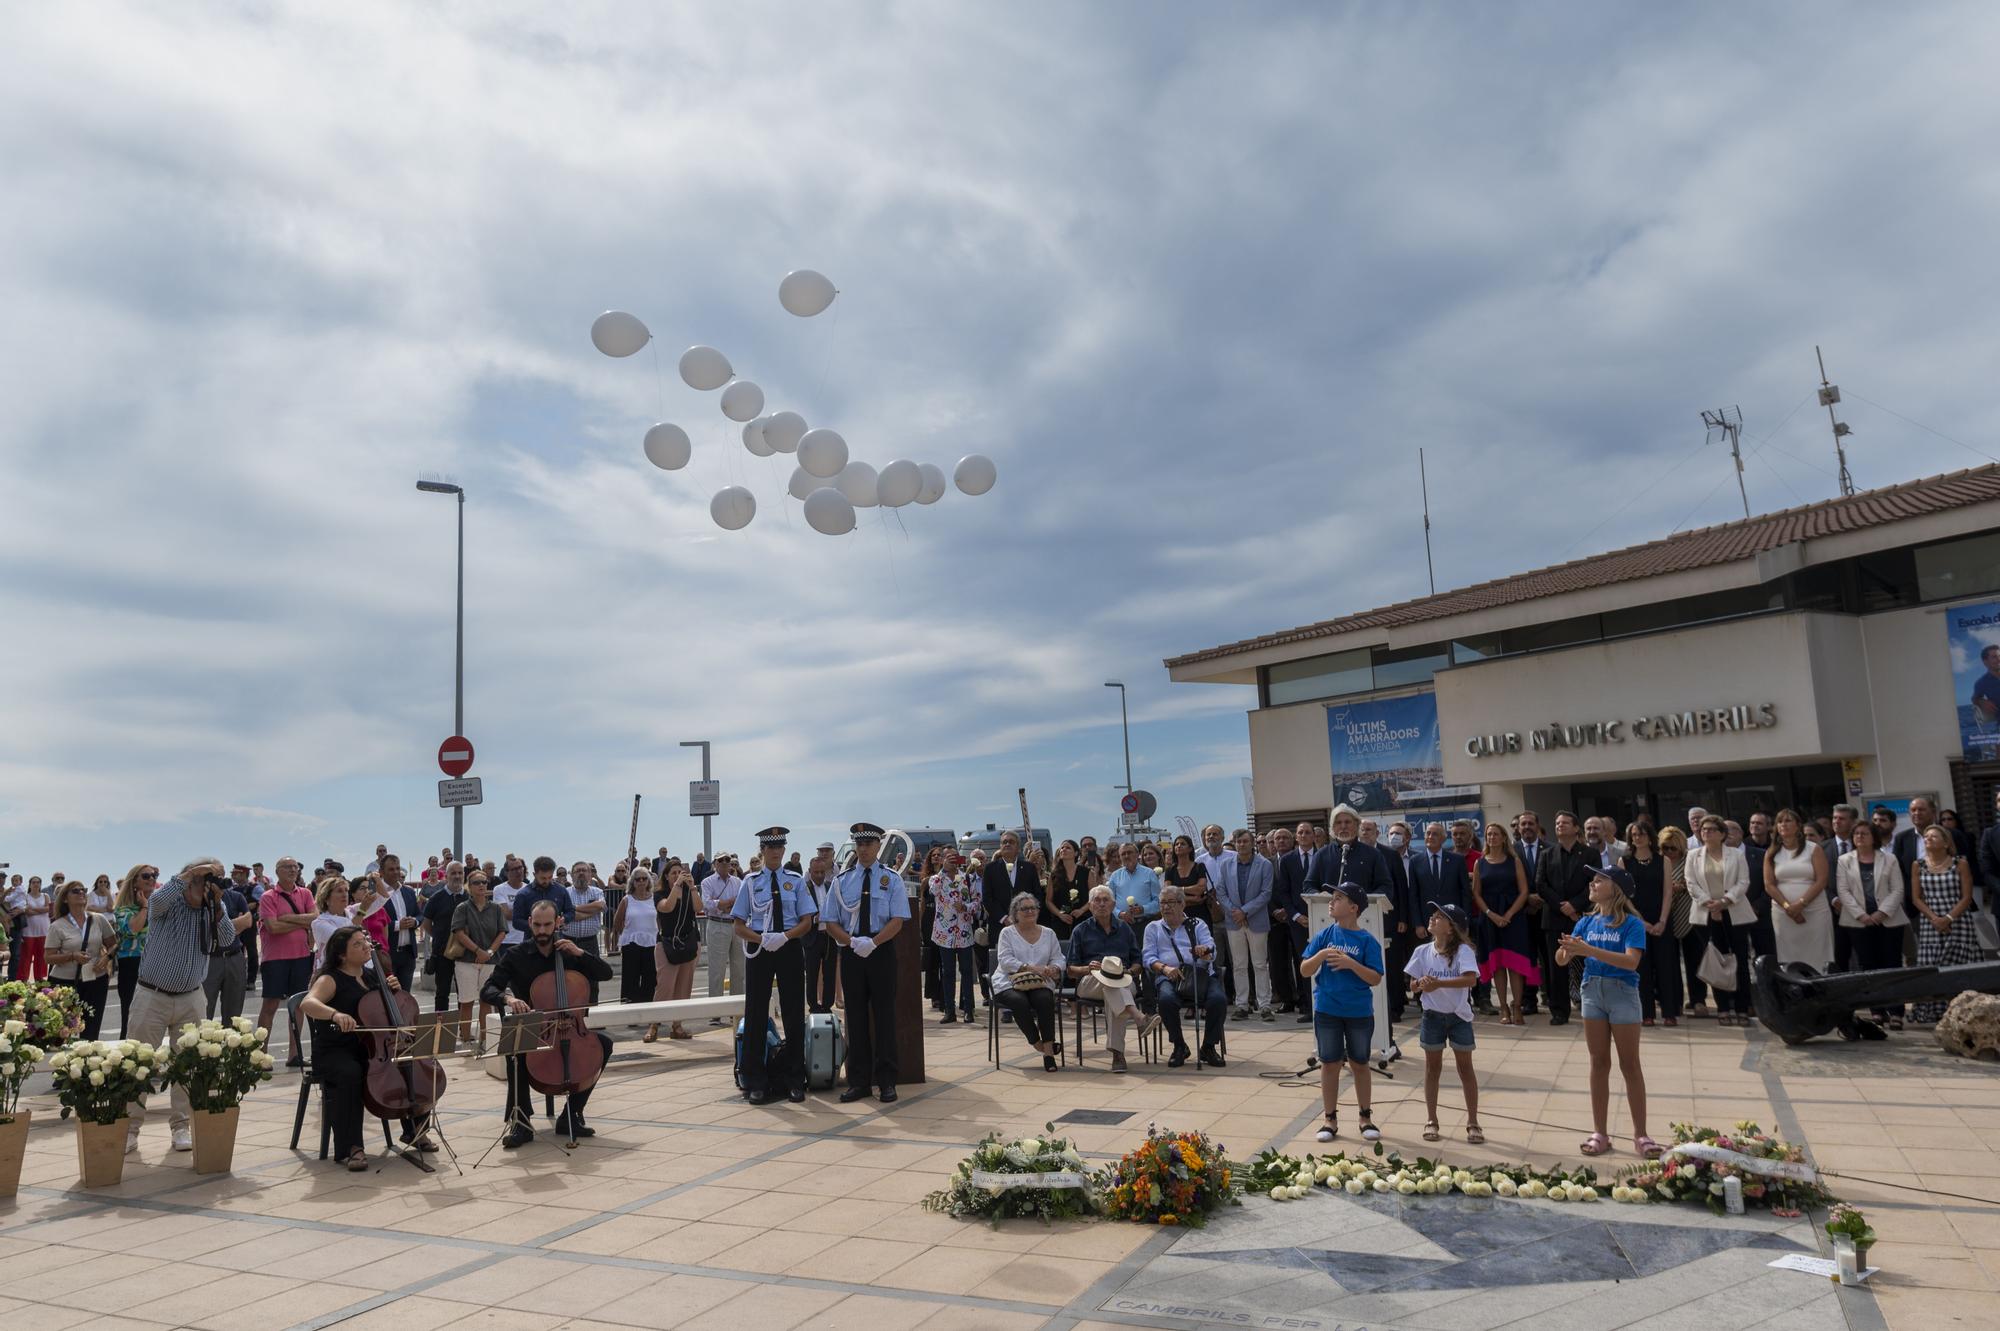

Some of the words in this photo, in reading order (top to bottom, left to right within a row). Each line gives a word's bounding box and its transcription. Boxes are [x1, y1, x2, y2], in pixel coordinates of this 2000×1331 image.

[1958, 615, 1992, 628] Escola
[1346, 720, 1387, 736] ÚLTIMS
[1464, 731, 1522, 759] CLUB
[1528, 720, 1626, 752] NÀUTIC
[1631, 702, 1778, 741] CAMBRILS
[1347, 727, 1420, 746] AMARRADORS
[1348, 745, 1355, 754] A
[1357, 743, 1369, 754] LA
[1370, 741, 1401, 753] VENDA
[1586, 930, 1621, 942] Cambrils
[1115, 1300, 1252, 1323] CAMBRILS
[1263, 1316, 1322, 1329] PER
